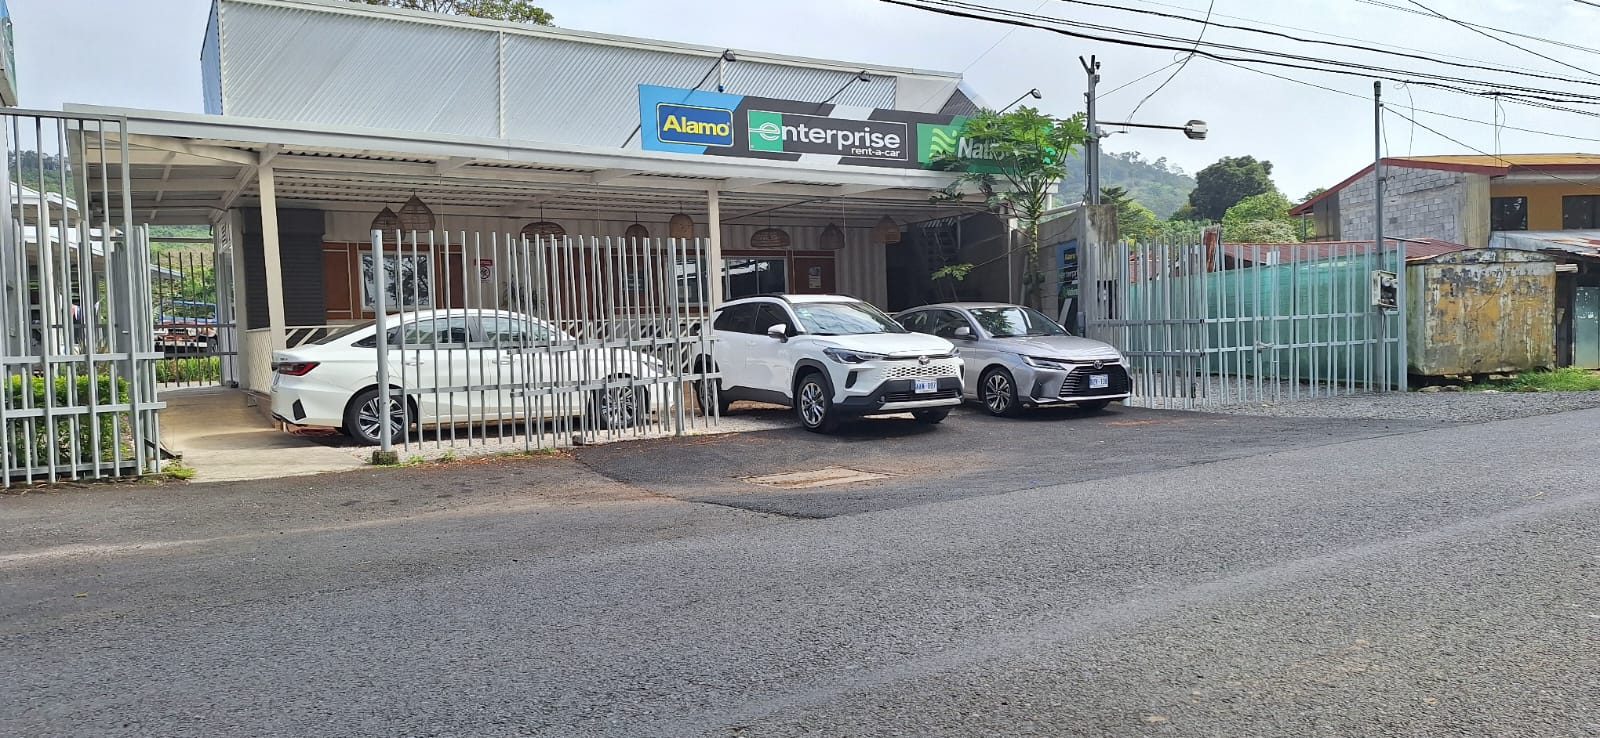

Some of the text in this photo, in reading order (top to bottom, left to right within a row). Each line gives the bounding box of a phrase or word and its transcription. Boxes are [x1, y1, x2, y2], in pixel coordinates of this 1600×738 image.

[663, 115, 730, 137] Alamo
[754, 122, 901, 150] enterprise
[851, 147, 901, 158] rent-a-car
[957, 136, 1011, 161] Natio
